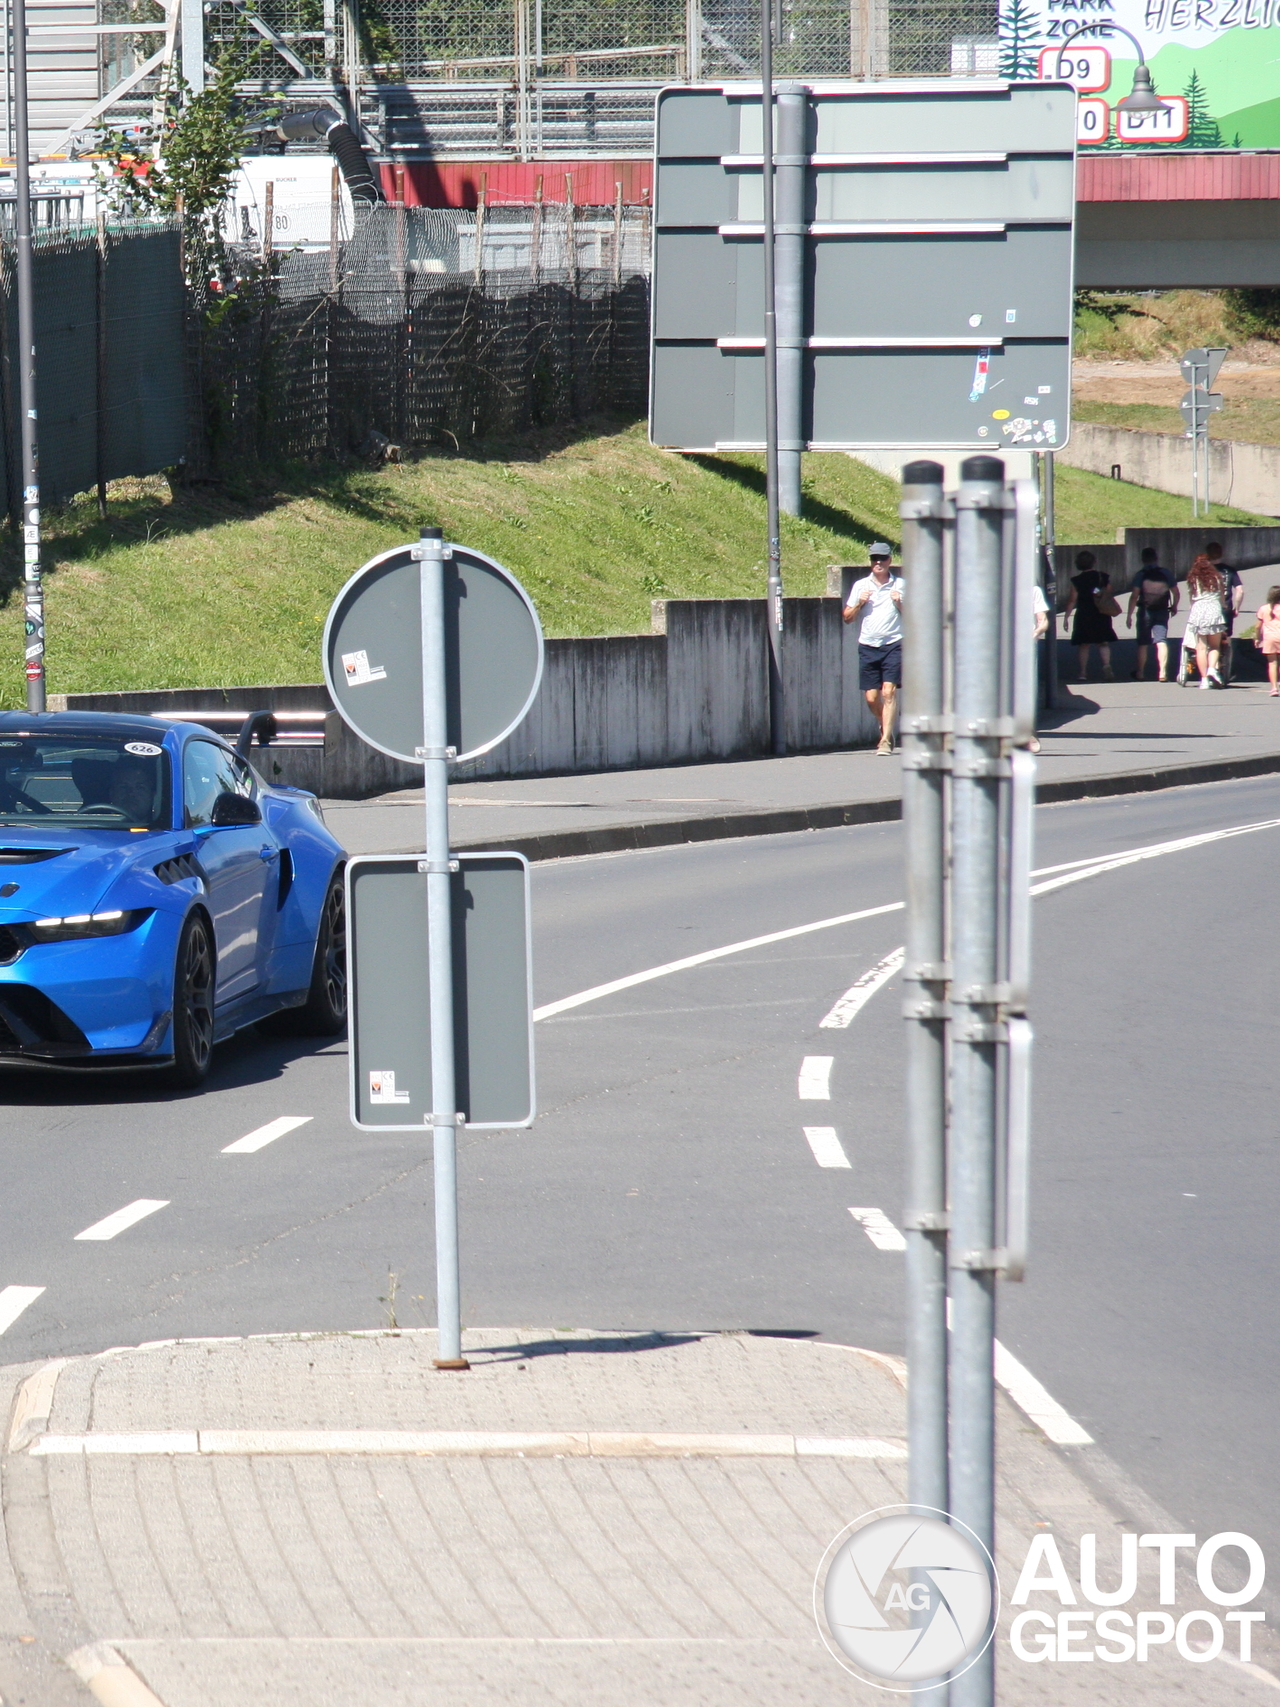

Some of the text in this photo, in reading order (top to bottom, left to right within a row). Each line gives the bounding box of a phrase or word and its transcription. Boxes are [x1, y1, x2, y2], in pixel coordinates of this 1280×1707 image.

[1048, 0, 1114, 11] PARK
[1145, 0, 1280, 31] HERZLI
[1046, 18, 1115, 38] ZONE
[1059, 58, 1090, 79] D9
[276, 216, 288, 230] 80
[131, 744, 154, 754] 626
